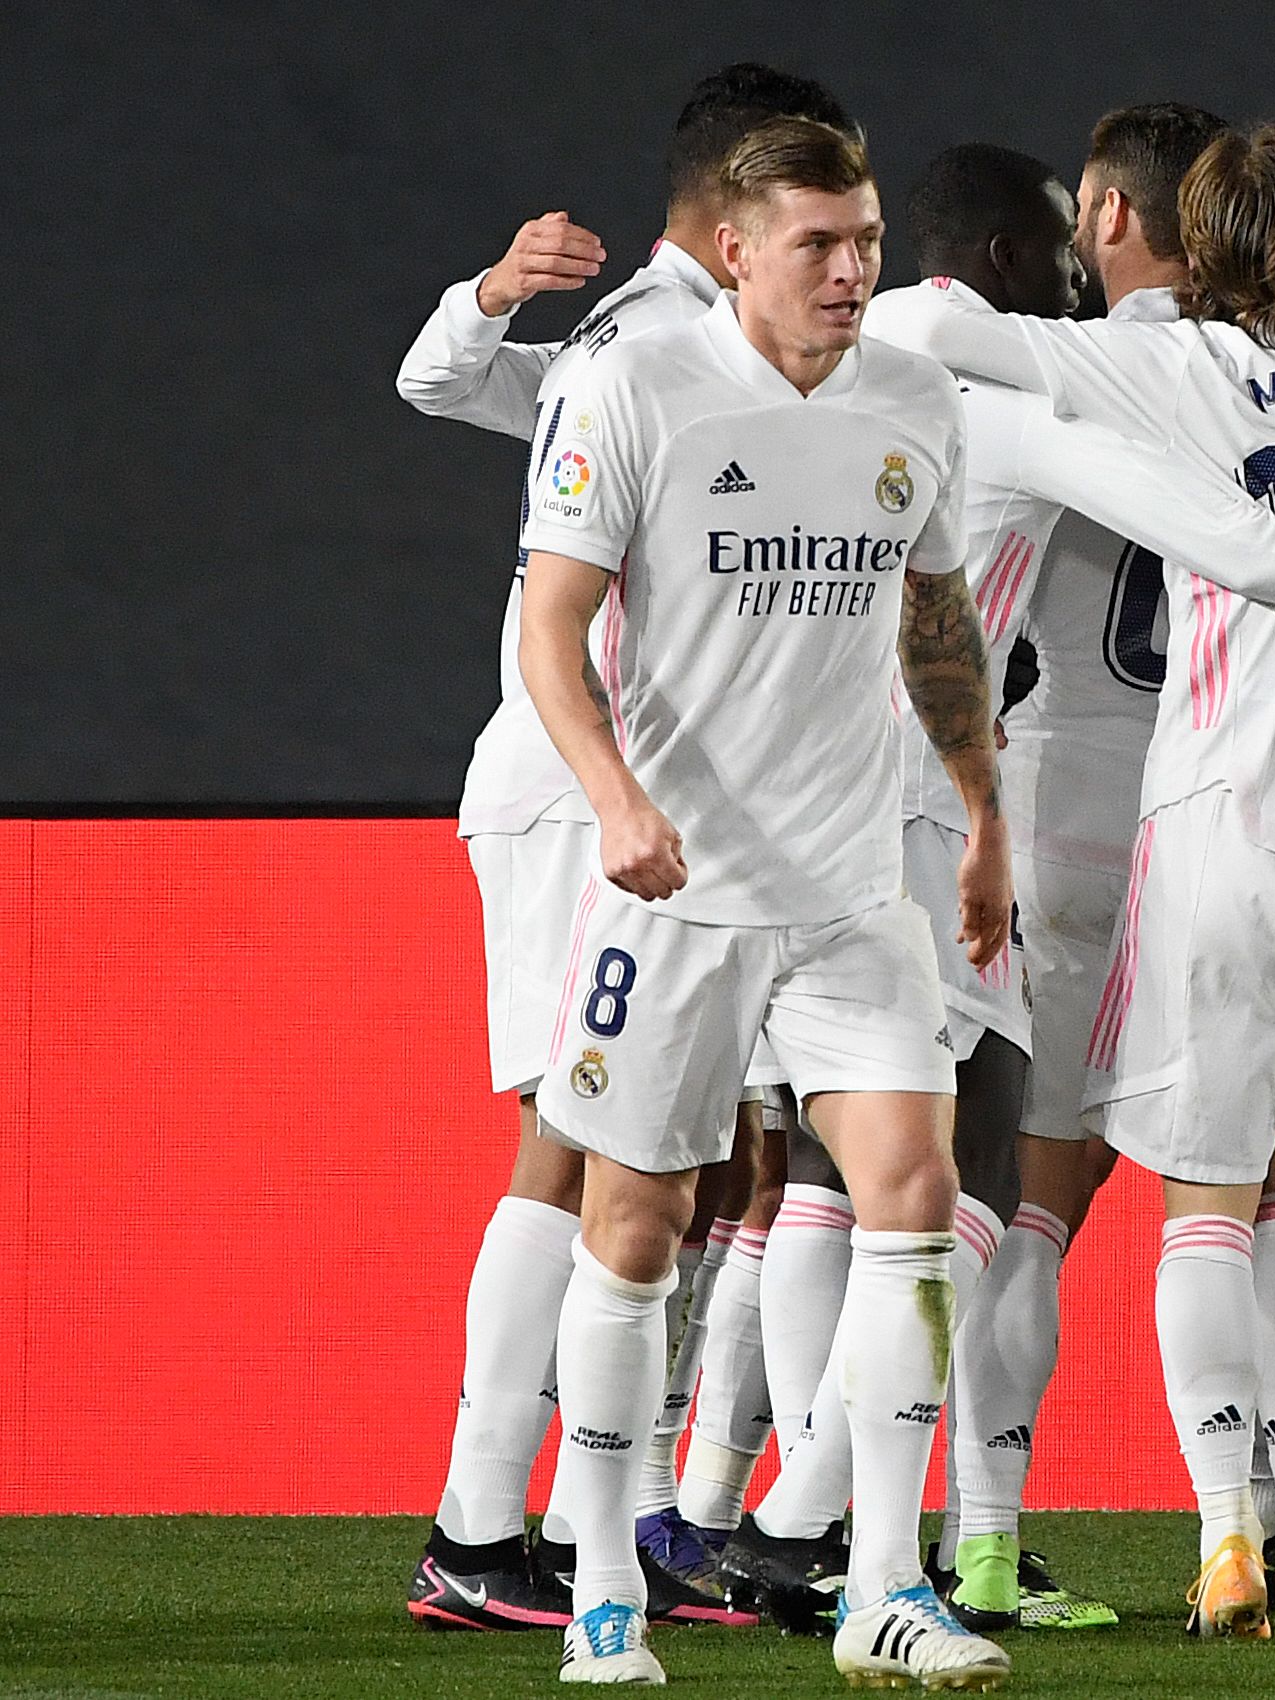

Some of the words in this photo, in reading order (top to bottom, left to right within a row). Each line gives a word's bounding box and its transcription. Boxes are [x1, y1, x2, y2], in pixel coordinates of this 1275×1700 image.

[709, 481, 756, 495] adidas
[543, 498, 582, 517] LaLiga
[707, 525, 908, 574] Emirates
[737, 580, 781, 617] FLY
[788, 580, 876, 617] BETTER
[580, 946, 638, 1041] 8
[578, 1426, 621, 1441] REAL
[1197, 1422, 1247, 1436] adidas
[570, 1433, 633, 1451] MADRID
[987, 1439, 1032, 1452] adida
